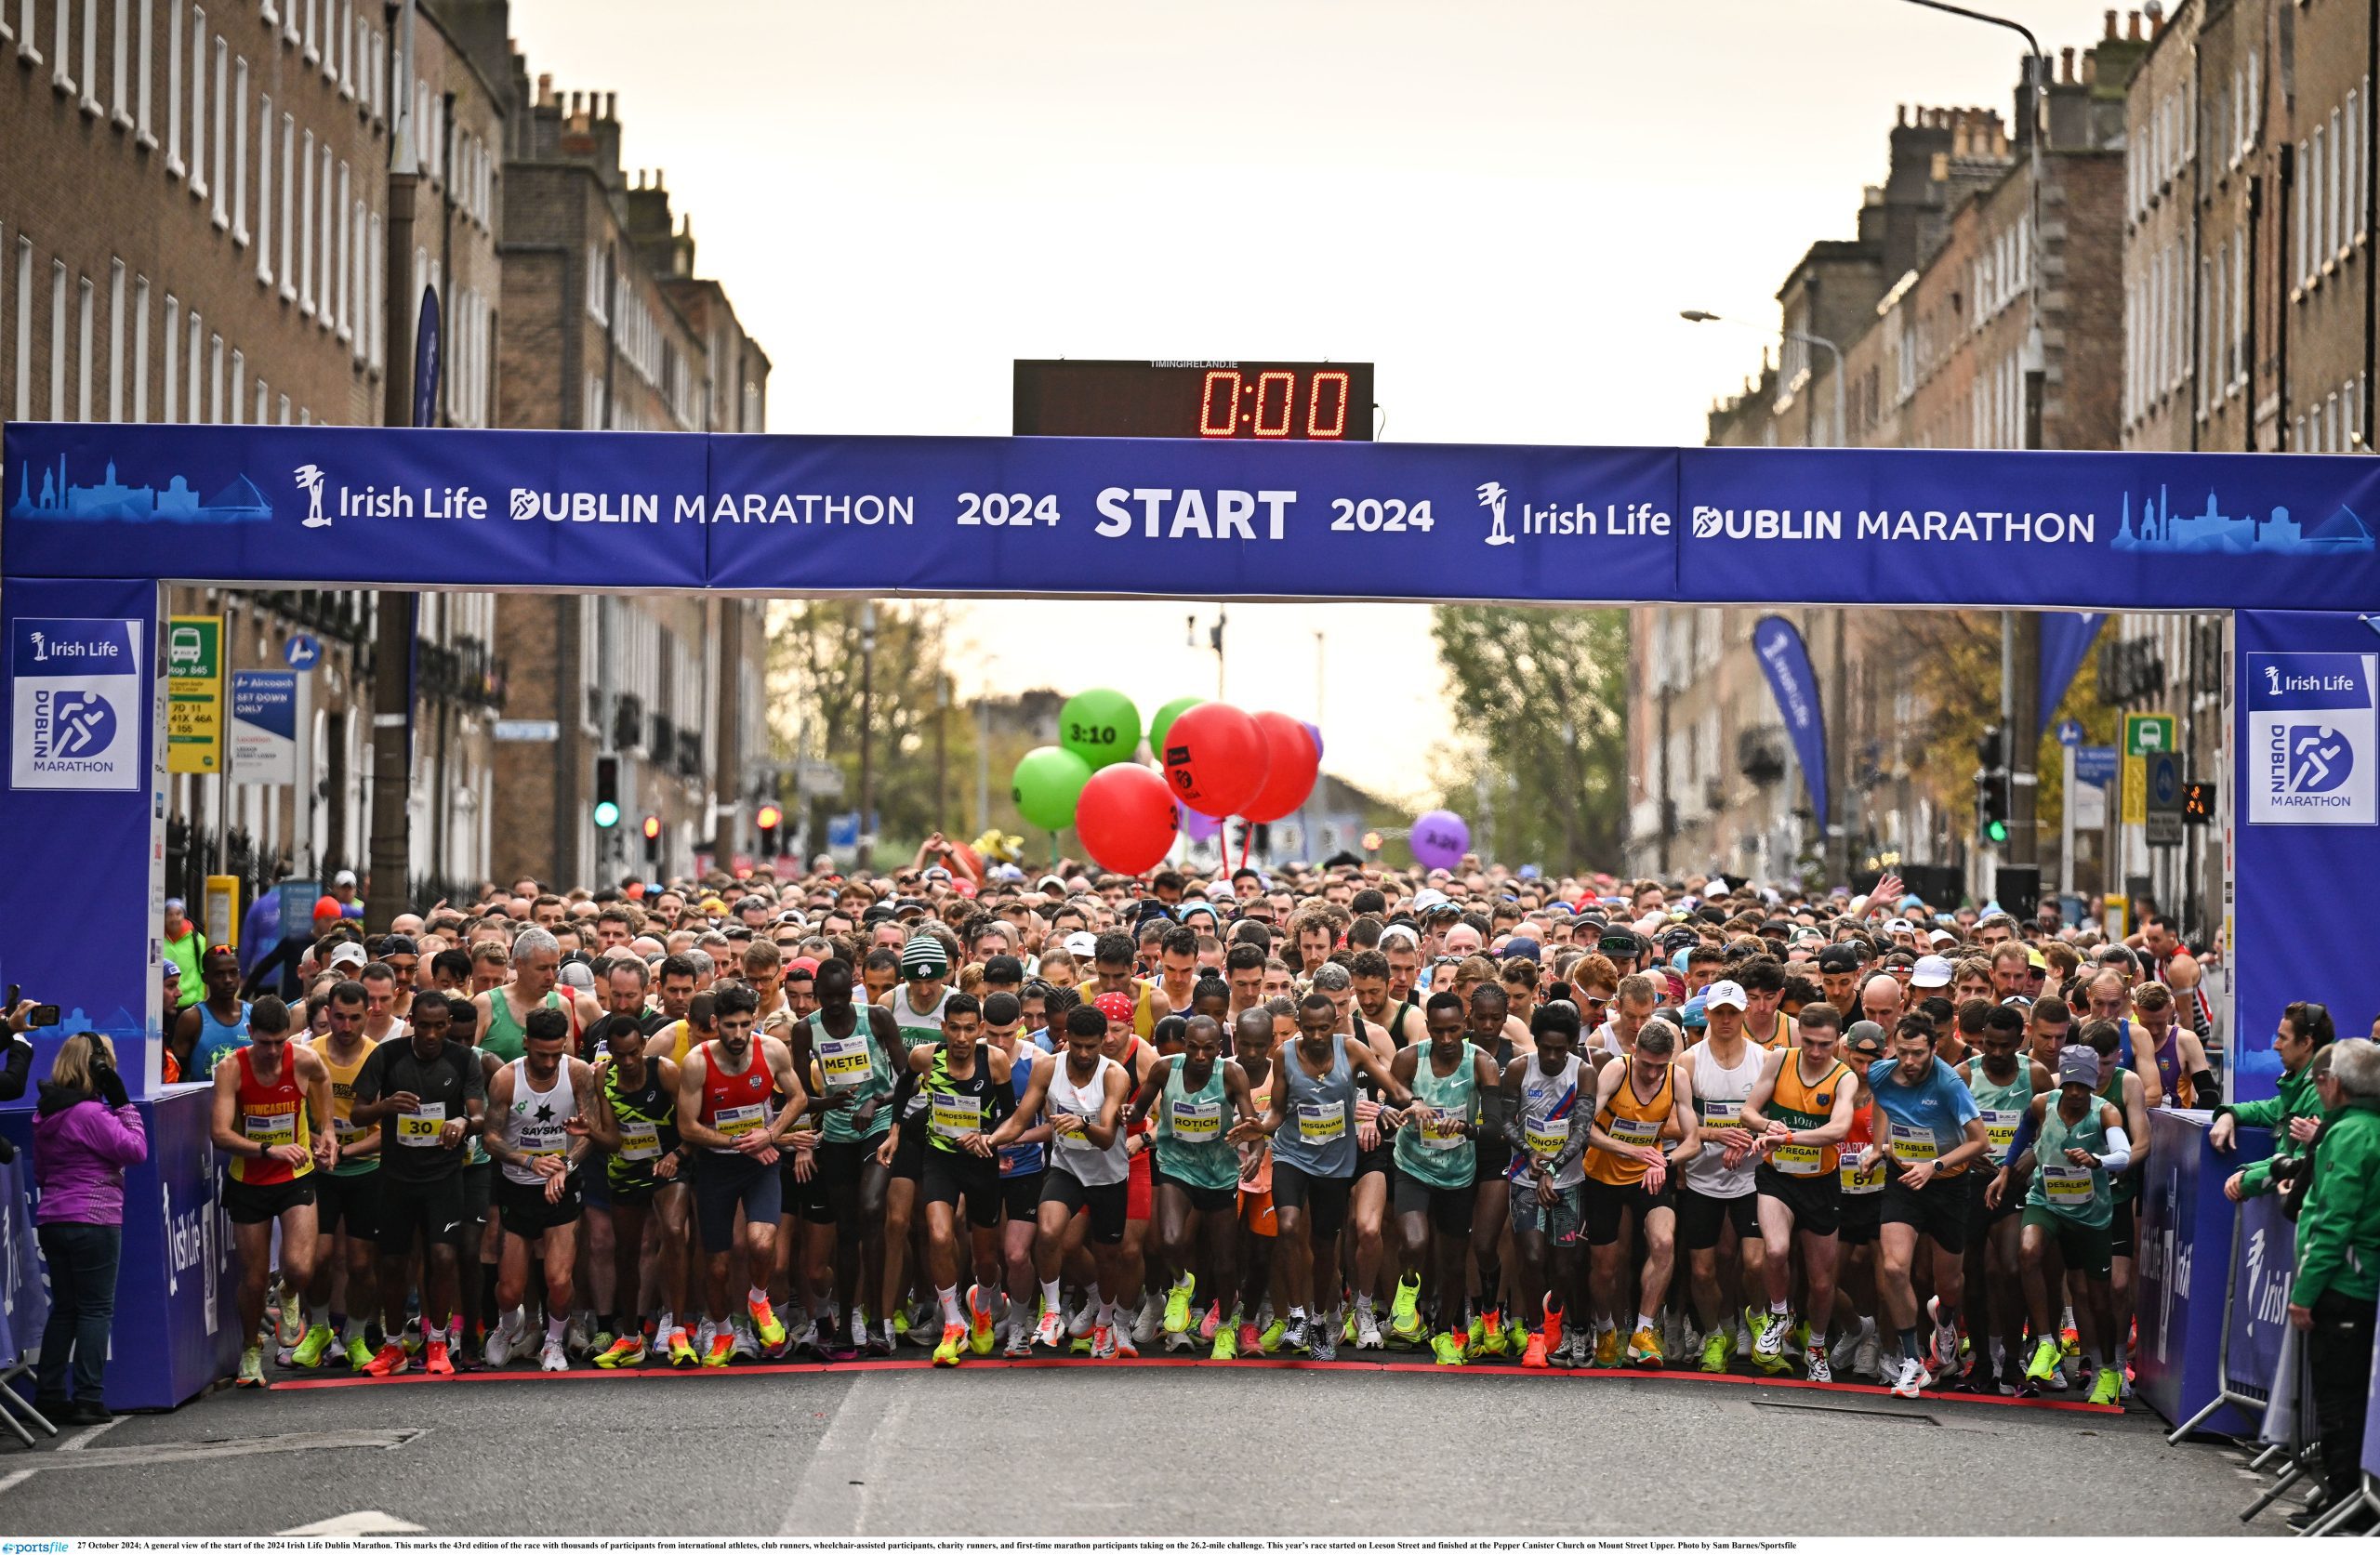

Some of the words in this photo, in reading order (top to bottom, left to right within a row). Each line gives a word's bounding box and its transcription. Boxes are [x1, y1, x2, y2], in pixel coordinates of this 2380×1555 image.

[1151, 360, 1238, 369] TIMINGIRELAND.IE
[1200, 371, 1348, 437] 0:00
[340, 486, 413, 518] Irish
[425, 487, 487, 520] Life
[510, 488, 657, 522] DUBLIN
[675, 494, 914, 525] MARATHON
[957, 492, 1060, 527] 2024
[1094, 487, 1297, 540] START
[1330, 498, 1435, 533] 2024
[1523, 503, 1593, 535] Irish
[1607, 504, 1672, 536] Life
[1693, 506, 1841, 540] DUBLIN
[1858, 511, 2095, 543] MARATHON
[51, 641, 85, 656] Irish
[89, 641, 118, 656] Life
[251, 678, 294, 688] Aircoach
[2285, 676, 2320, 691] Irish
[2324, 676, 2354, 691] Life
[237, 693, 254, 702] SET
[256, 693, 287, 703] DOWN
[237, 705, 263, 713] ONLY
[34, 691, 49, 758] DUBLIN
[1071, 722, 1116, 745] 3:10
[2271, 724, 2284, 792] DUBLIN
[33, 761, 113, 772] MARATHON
[2271, 796, 2351, 807] MARATHON
[825, 1054, 868, 1069] METEI
[244, 1100, 296, 1115] NEWCASTLE
[935, 1111, 978, 1121] LAMDESSEM
[409, 1121, 432, 1134] 30
[719, 1118, 762, 1131] ARMSTRONG
[1174, 1117, 1219, 1127] ROTICH
[1301, 1118, 1343, 1129] MISGANAW
[248, 1131, 292, 1140] FORSYTH
[522, 1125, 564, 1136] SAYSKY
[1987, 1129, 2016, 1138] ALEW
[1527, 1134, 1566, 1146] TONOSA
[1610, 1133, 1653, 1144] CREESH
[1894, 1141, 1935, 1153] STABLER
[2047, 1179, 2091, 1189] DESALEW
[172, 1213, 188, 1272] Irish
[188, 1208, 201, 1266] Life
